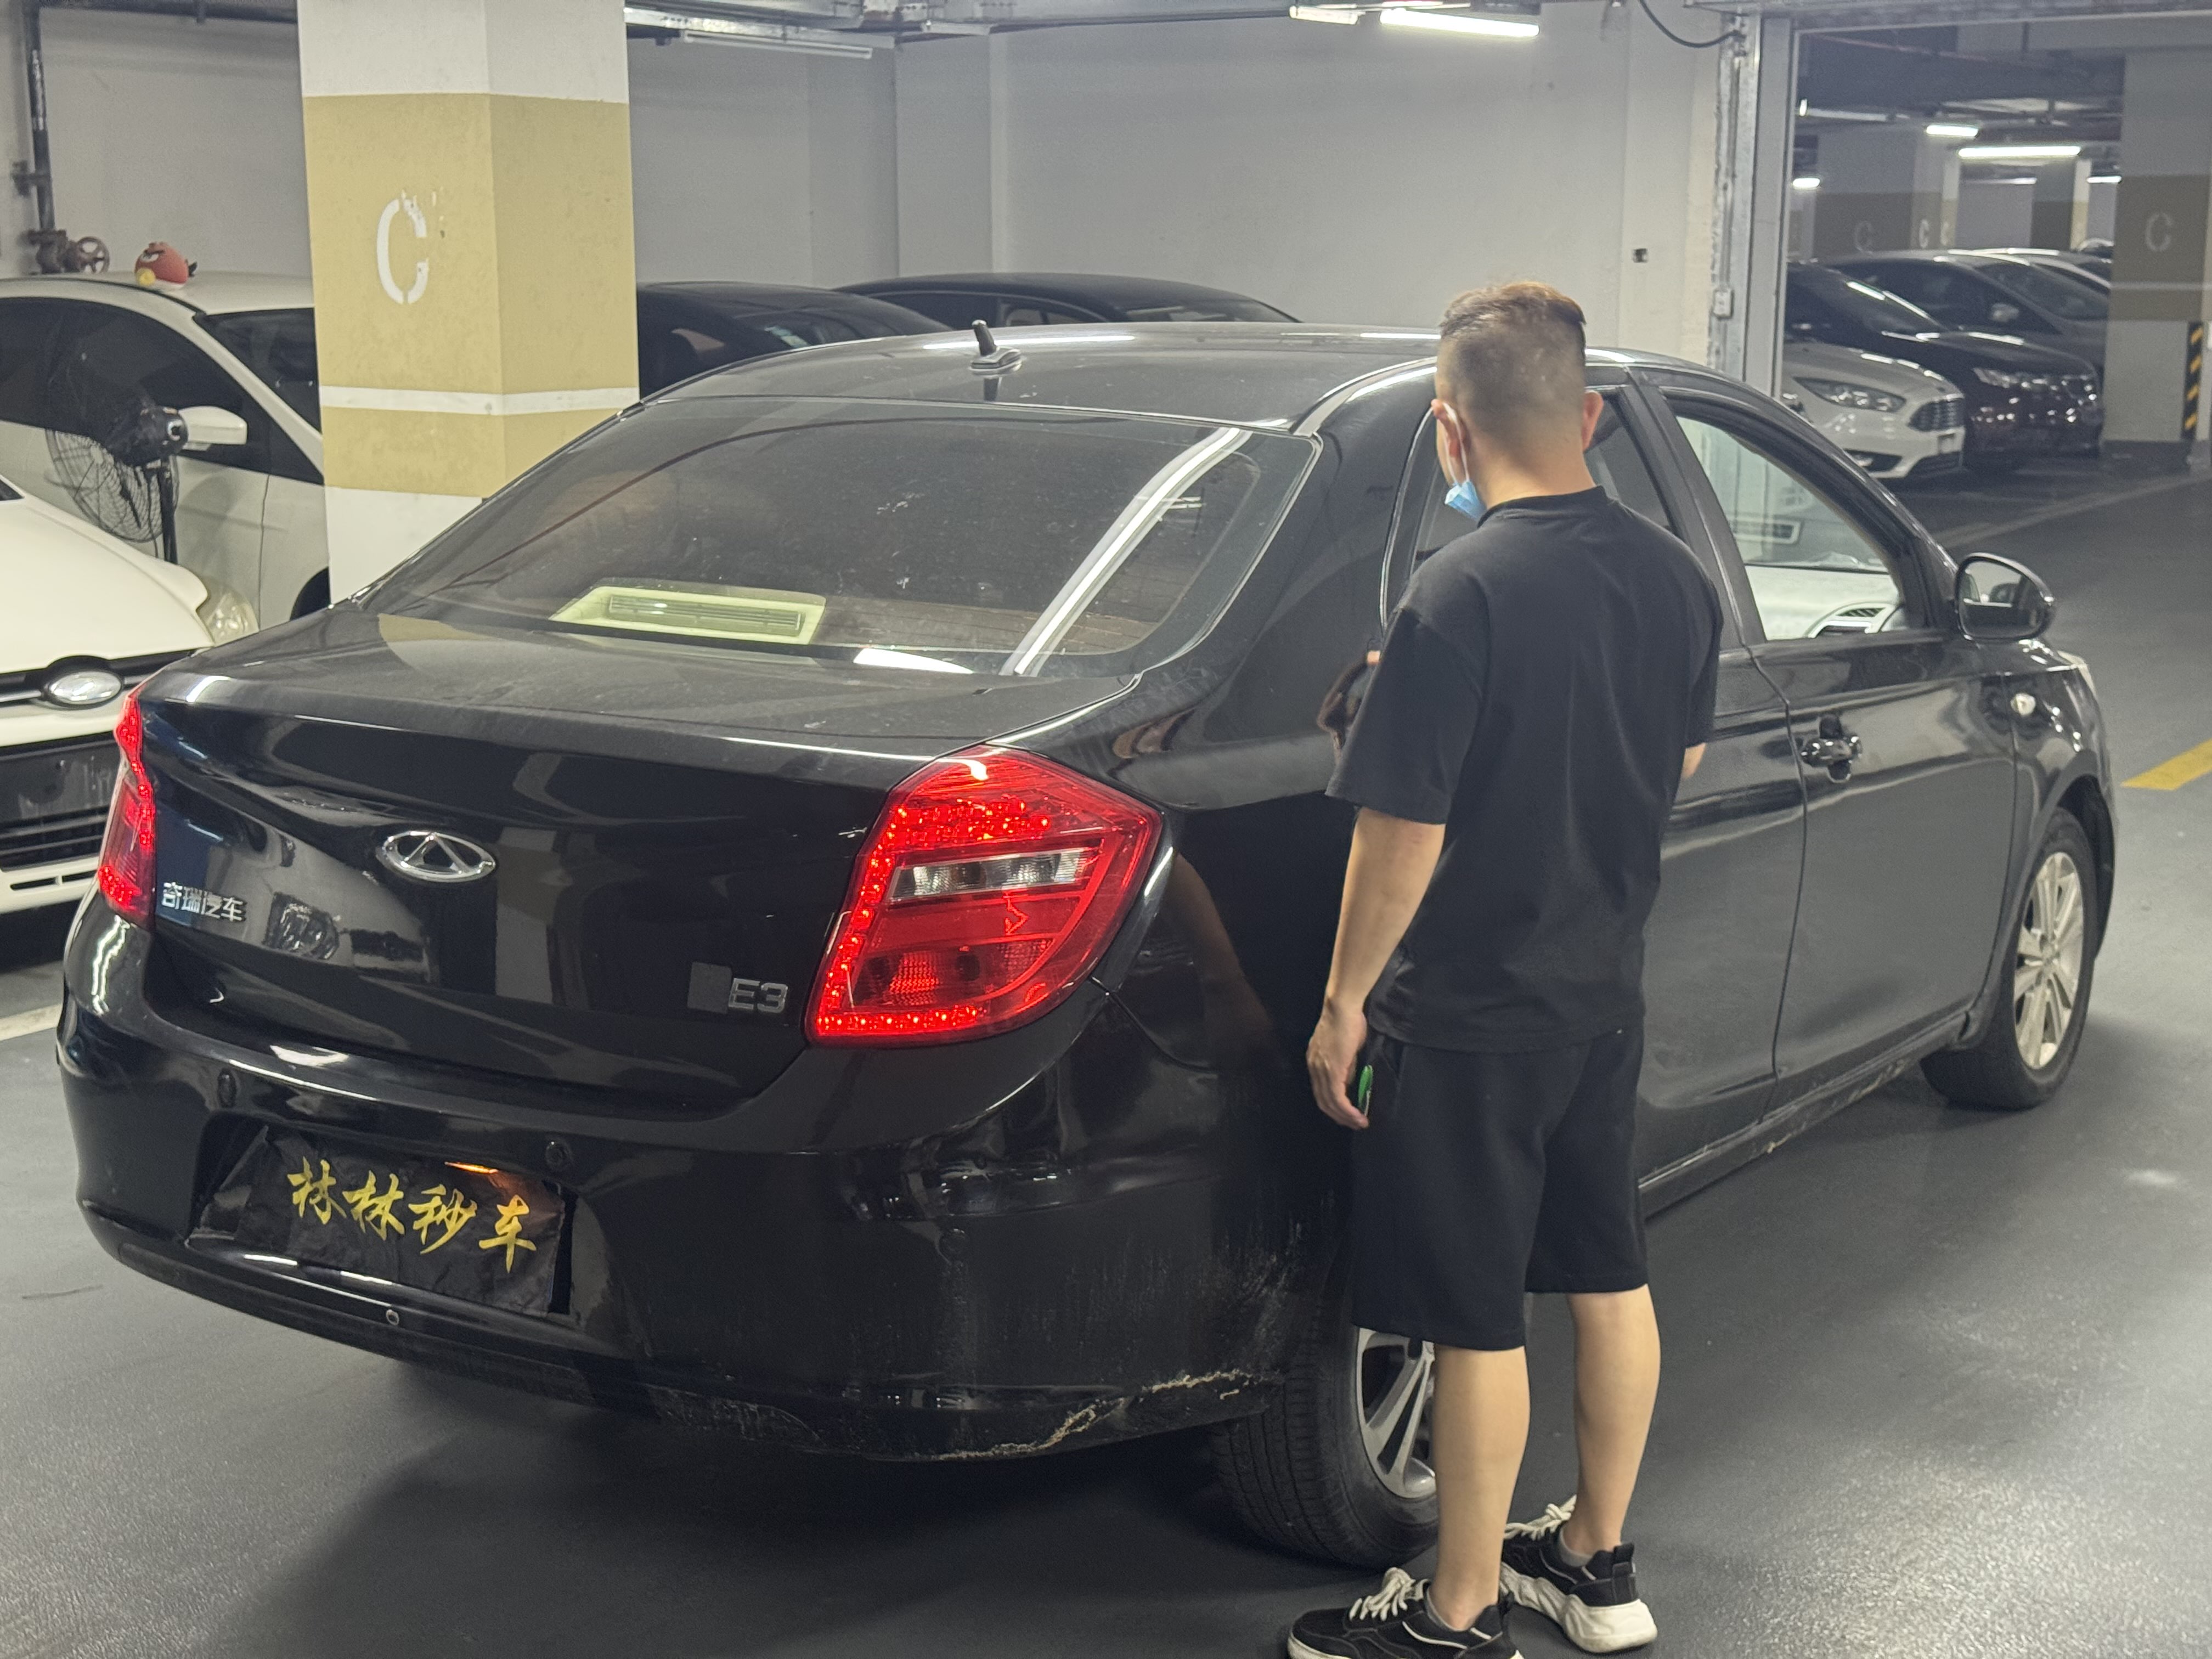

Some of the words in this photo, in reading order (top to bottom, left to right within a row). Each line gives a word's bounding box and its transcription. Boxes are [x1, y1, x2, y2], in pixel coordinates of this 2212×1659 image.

[376, 198, 430, 304] C
[2146, 212, 2172, 252] C
[162, 882, 244, 922] 奇瑞汽车
[728, 977, 788, 1013] E3
